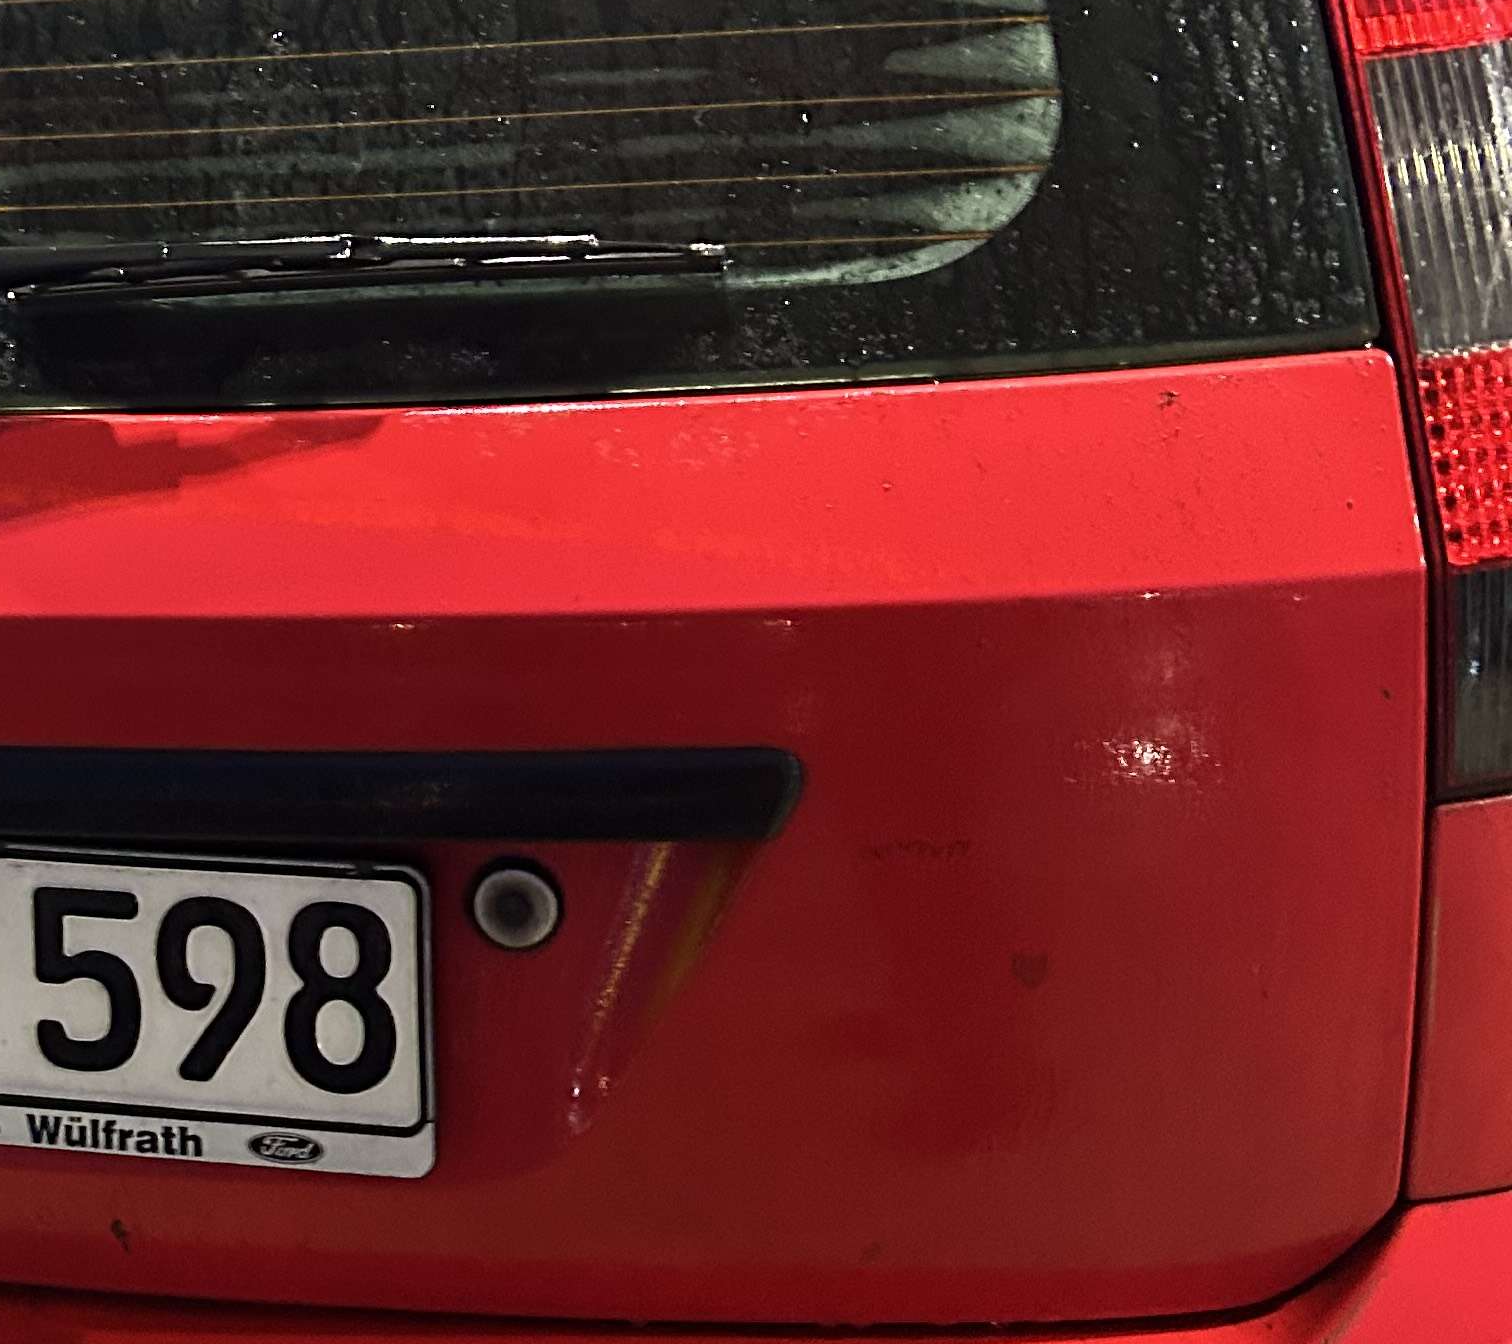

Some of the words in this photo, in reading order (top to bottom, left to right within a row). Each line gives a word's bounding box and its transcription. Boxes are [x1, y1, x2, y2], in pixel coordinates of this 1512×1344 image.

[32, 885, 397, 1095] 598
[25, 1112, 204, 1158] Wülfrath
[258, 1132, 321, 1161] Ford
